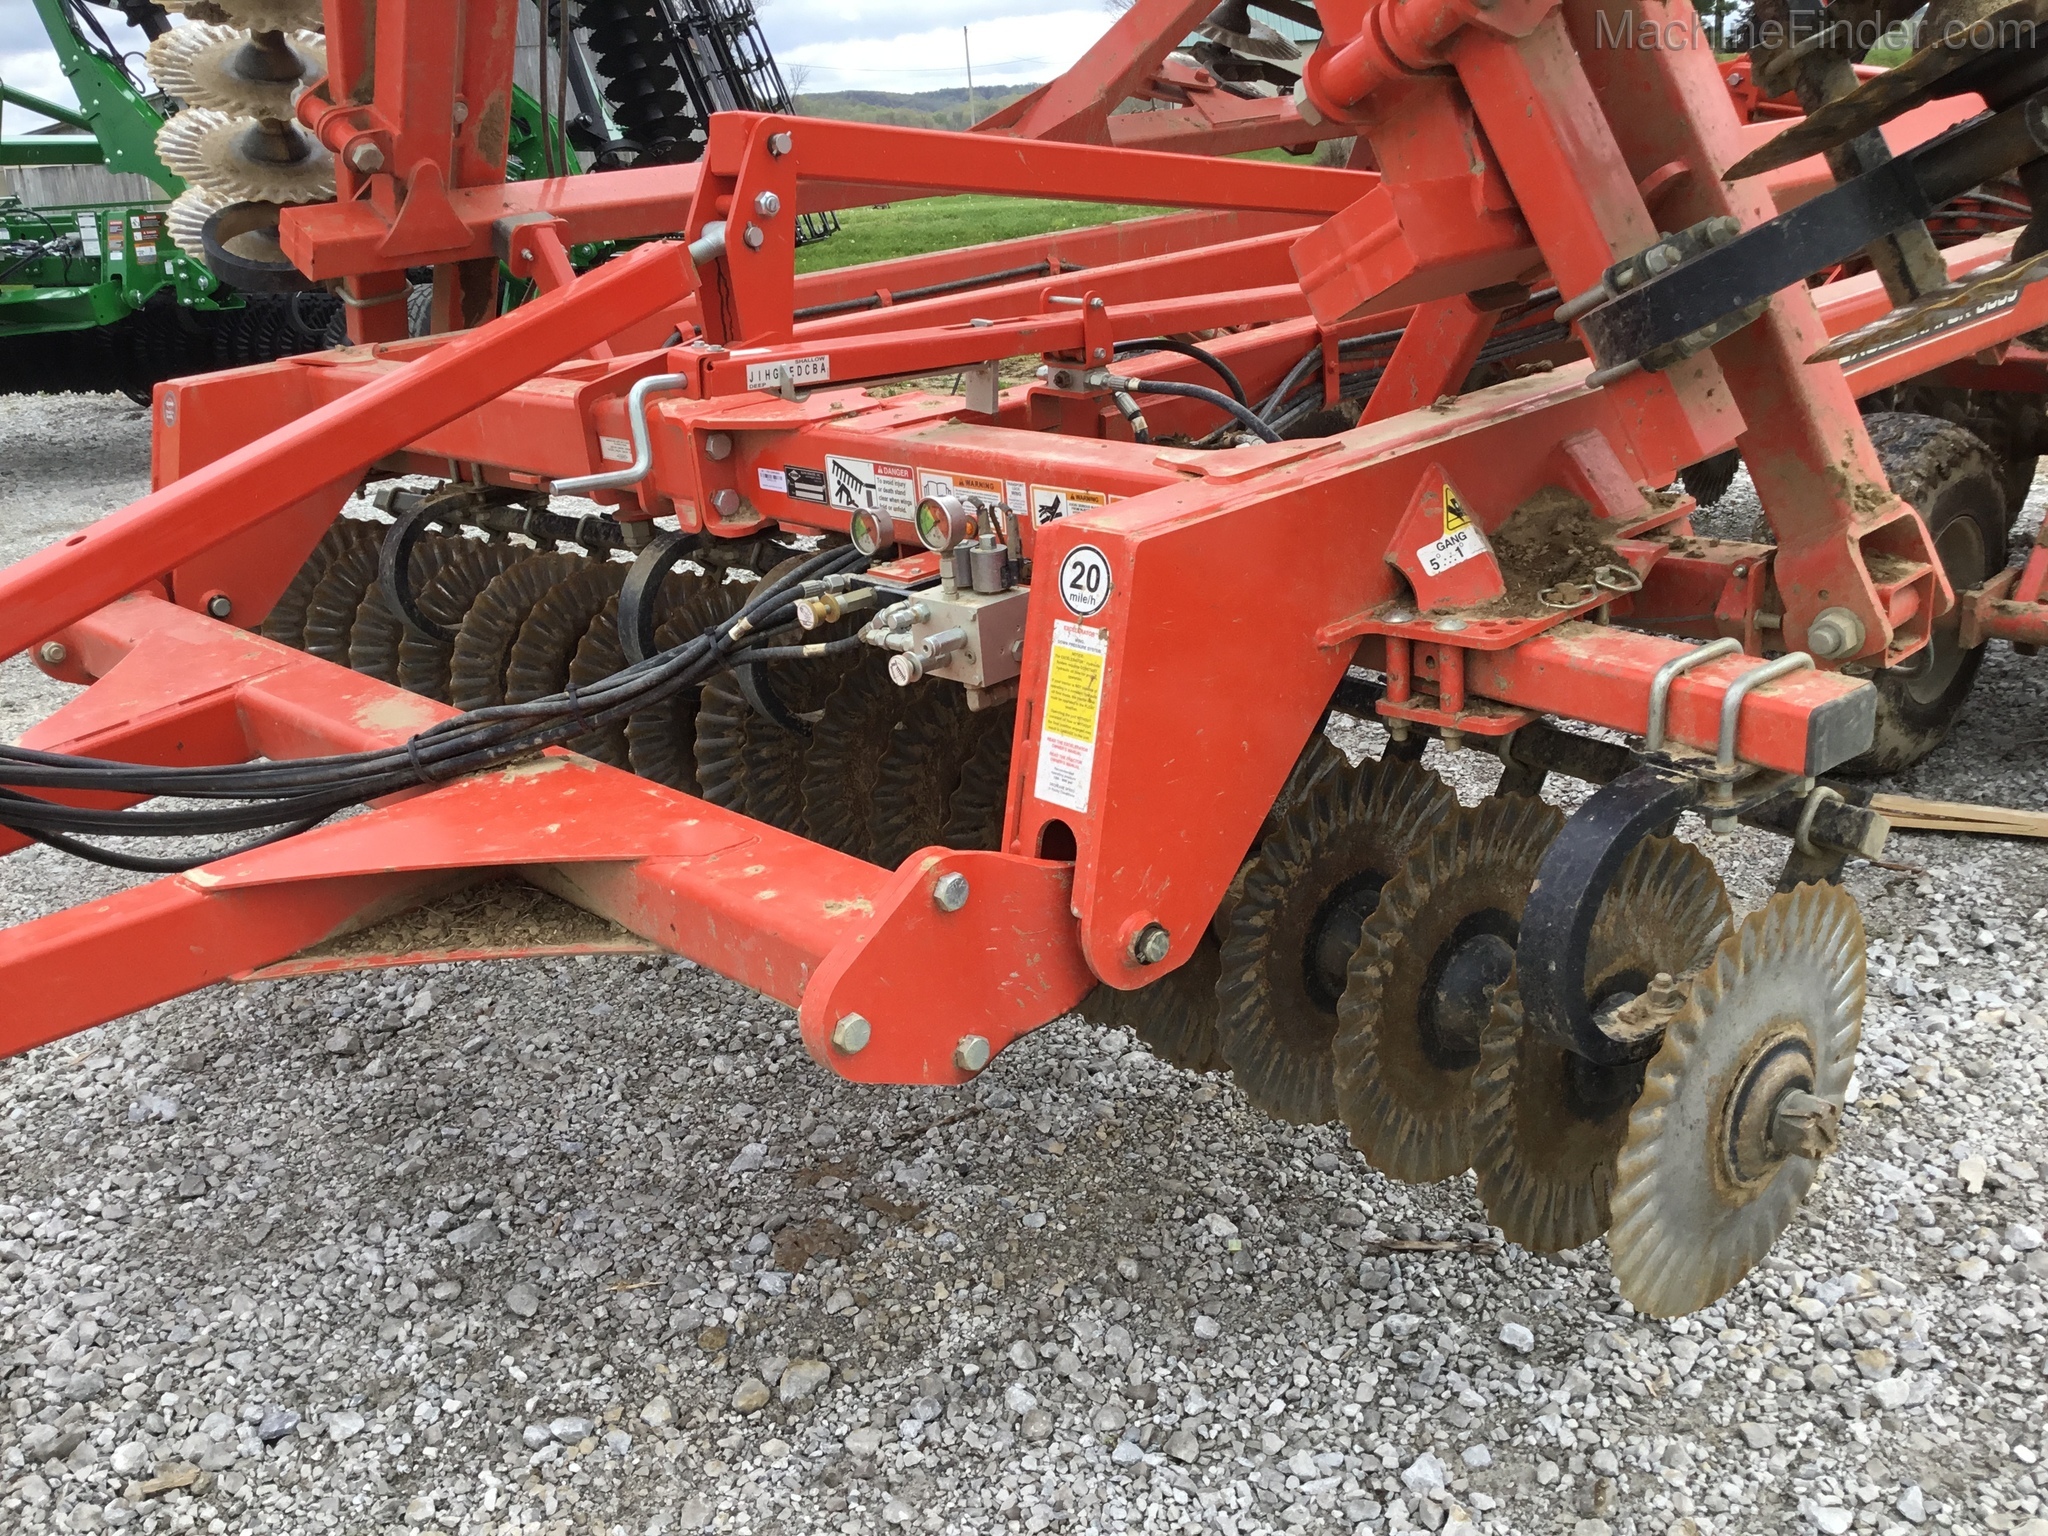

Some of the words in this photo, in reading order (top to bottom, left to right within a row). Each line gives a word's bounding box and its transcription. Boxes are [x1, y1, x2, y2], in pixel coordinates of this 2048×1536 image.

[795, 356, 825, 364] SHALLOW
[883, 466, 909, 478] DANGER
[895, 480, 906, 488] injury
[965, 479, 994, 490] WARNING
[900, 499, 912, 507] wings
[1075, 494, 1099, 503] WARNING
[1436, 531, 1468, 552] GANG
[1069, 560, 1101, 593] 20
[1069, 592, 1096, 606] mile/h
